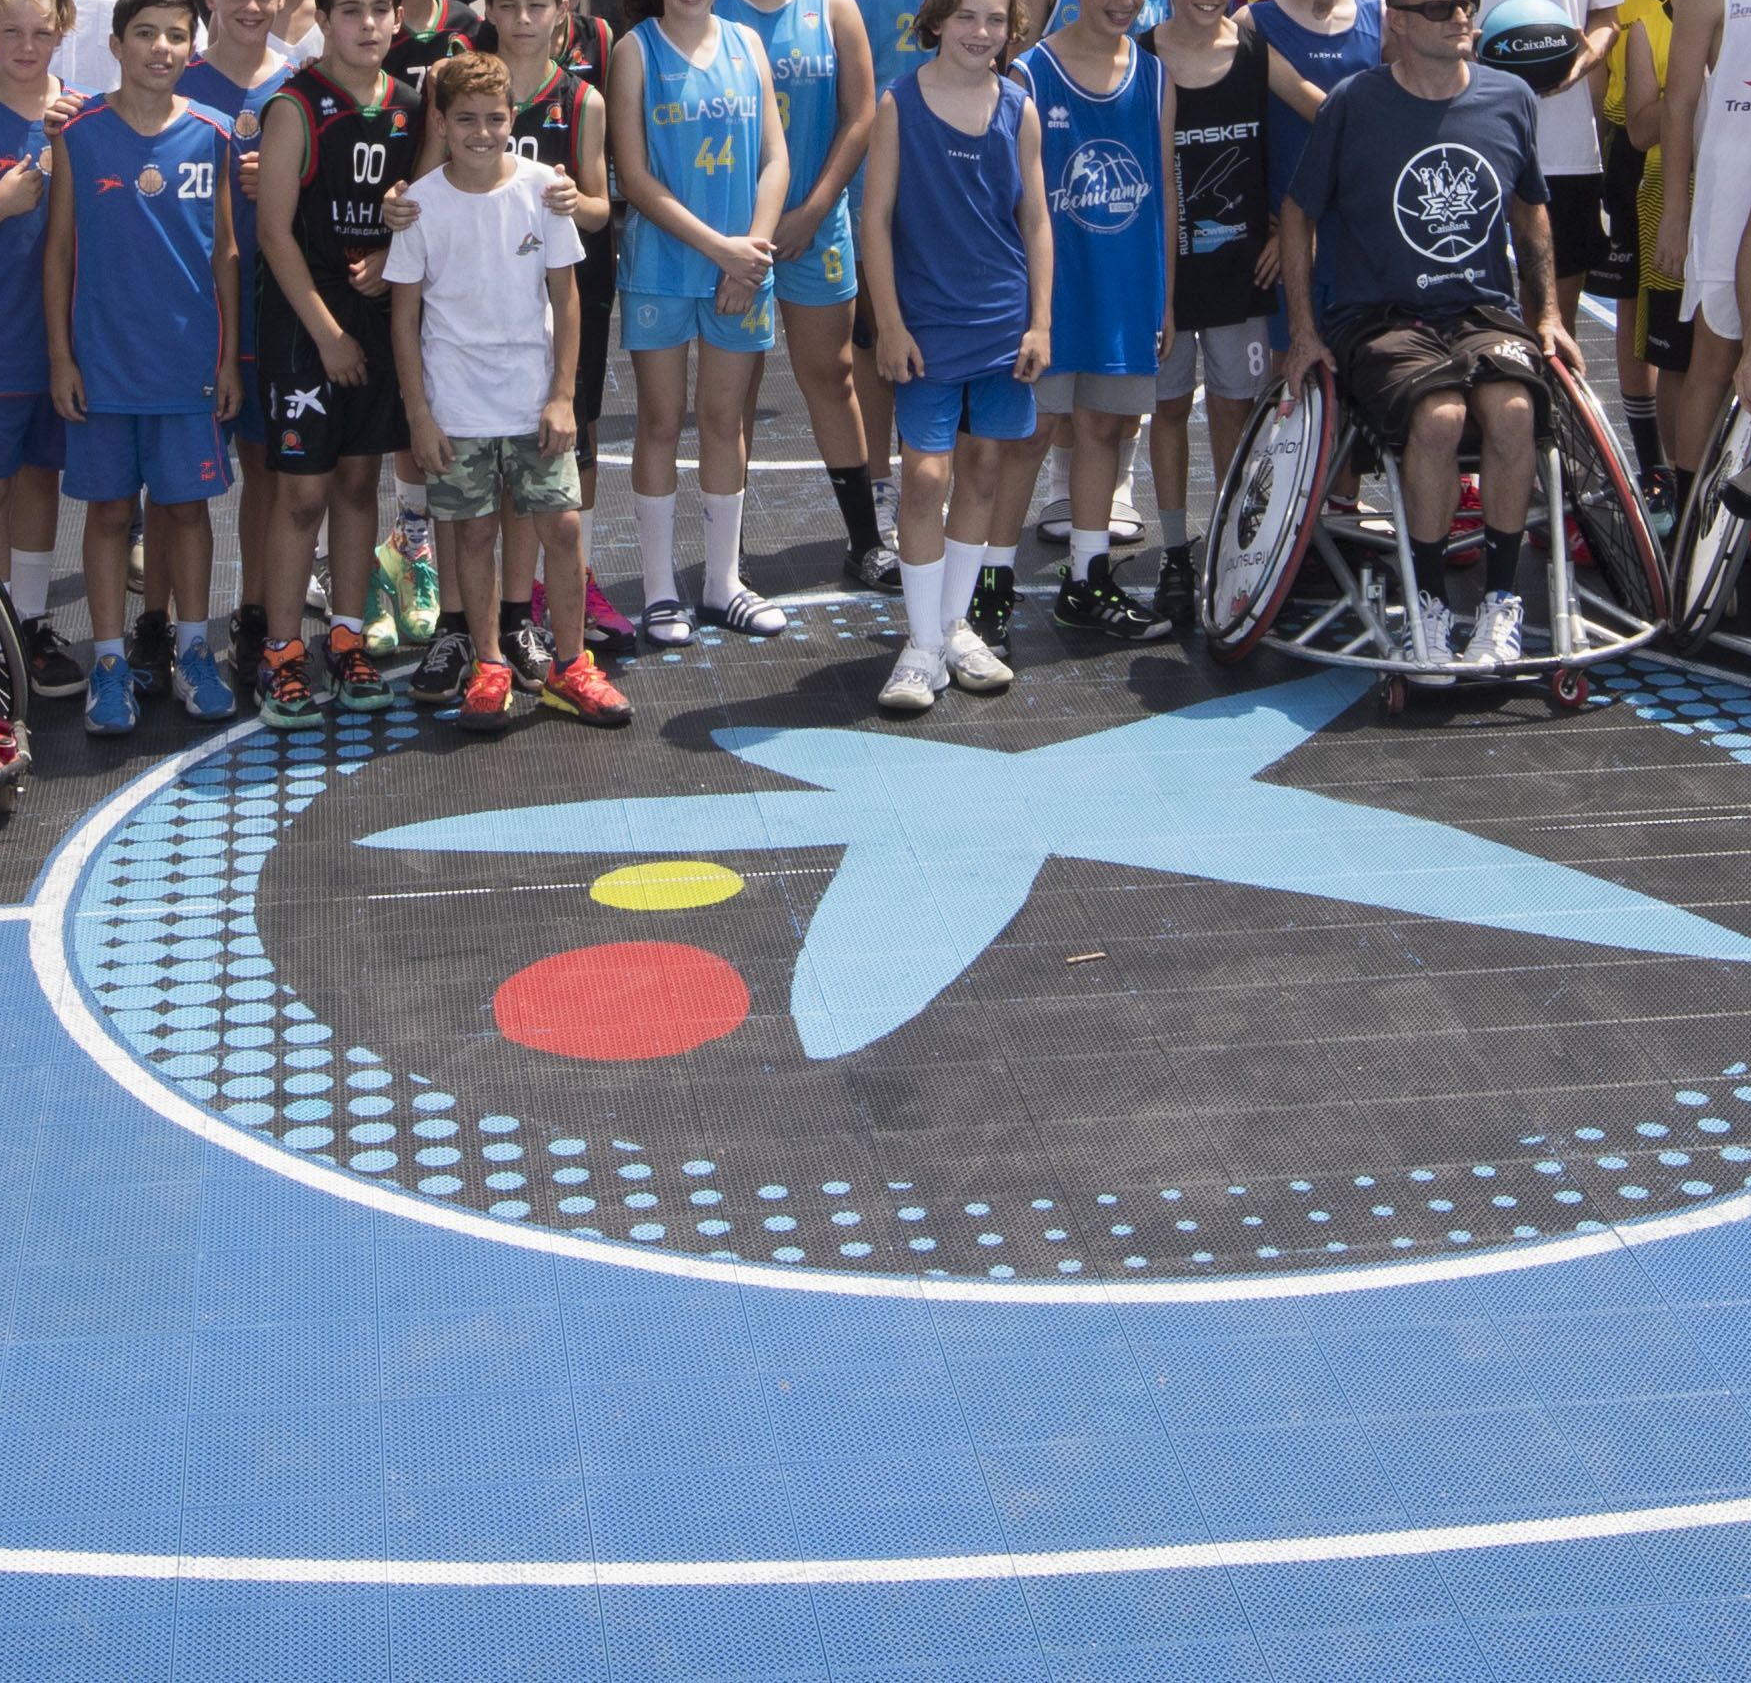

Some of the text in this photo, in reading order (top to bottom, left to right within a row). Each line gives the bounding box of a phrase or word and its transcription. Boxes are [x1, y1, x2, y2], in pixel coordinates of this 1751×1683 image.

[1511, 34, 1568, 52] CaixaBank
[1173, 120, 1261, 146] BASKET
[352, 141, 387, 184] 00
[694, 134, 736, 176] 44
[948, 150, 981, 161] TARMAK
[177, 162, 215, 199] 20
[1176, 225, 1189, 255] RUDY
[822, 249, 843, 283] 8
[740, 299, 770, 333] 44
[1248, 341, 1265, 377] 8
